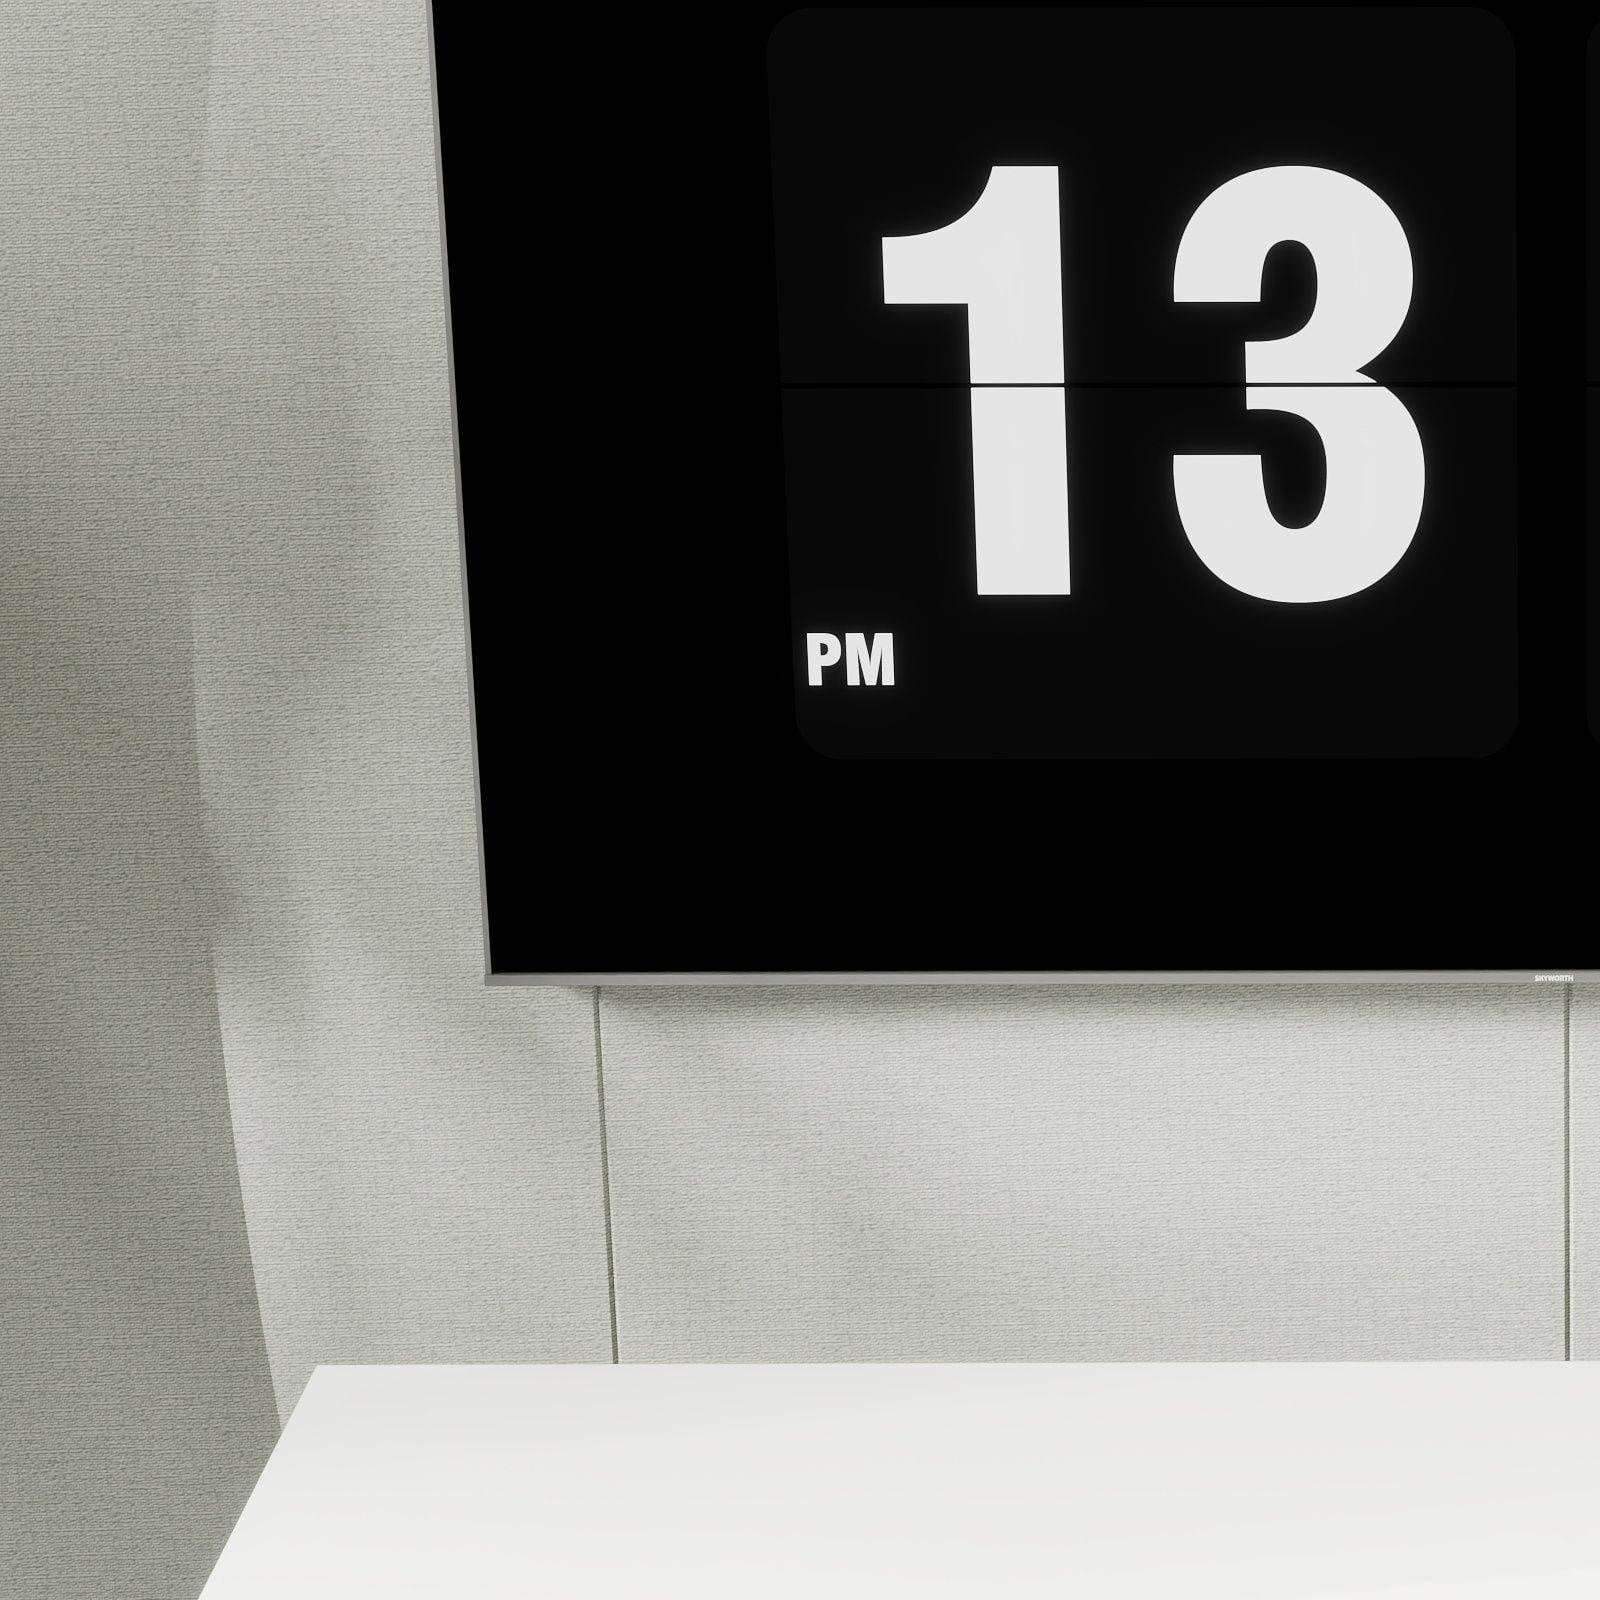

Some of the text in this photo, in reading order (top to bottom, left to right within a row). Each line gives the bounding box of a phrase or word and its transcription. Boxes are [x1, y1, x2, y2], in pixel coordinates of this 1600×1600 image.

[882, 165, 1426, 604] 13
[806, 632, 895, 687] PM
[1534, 974, 1574, 982] SKYWORTH
